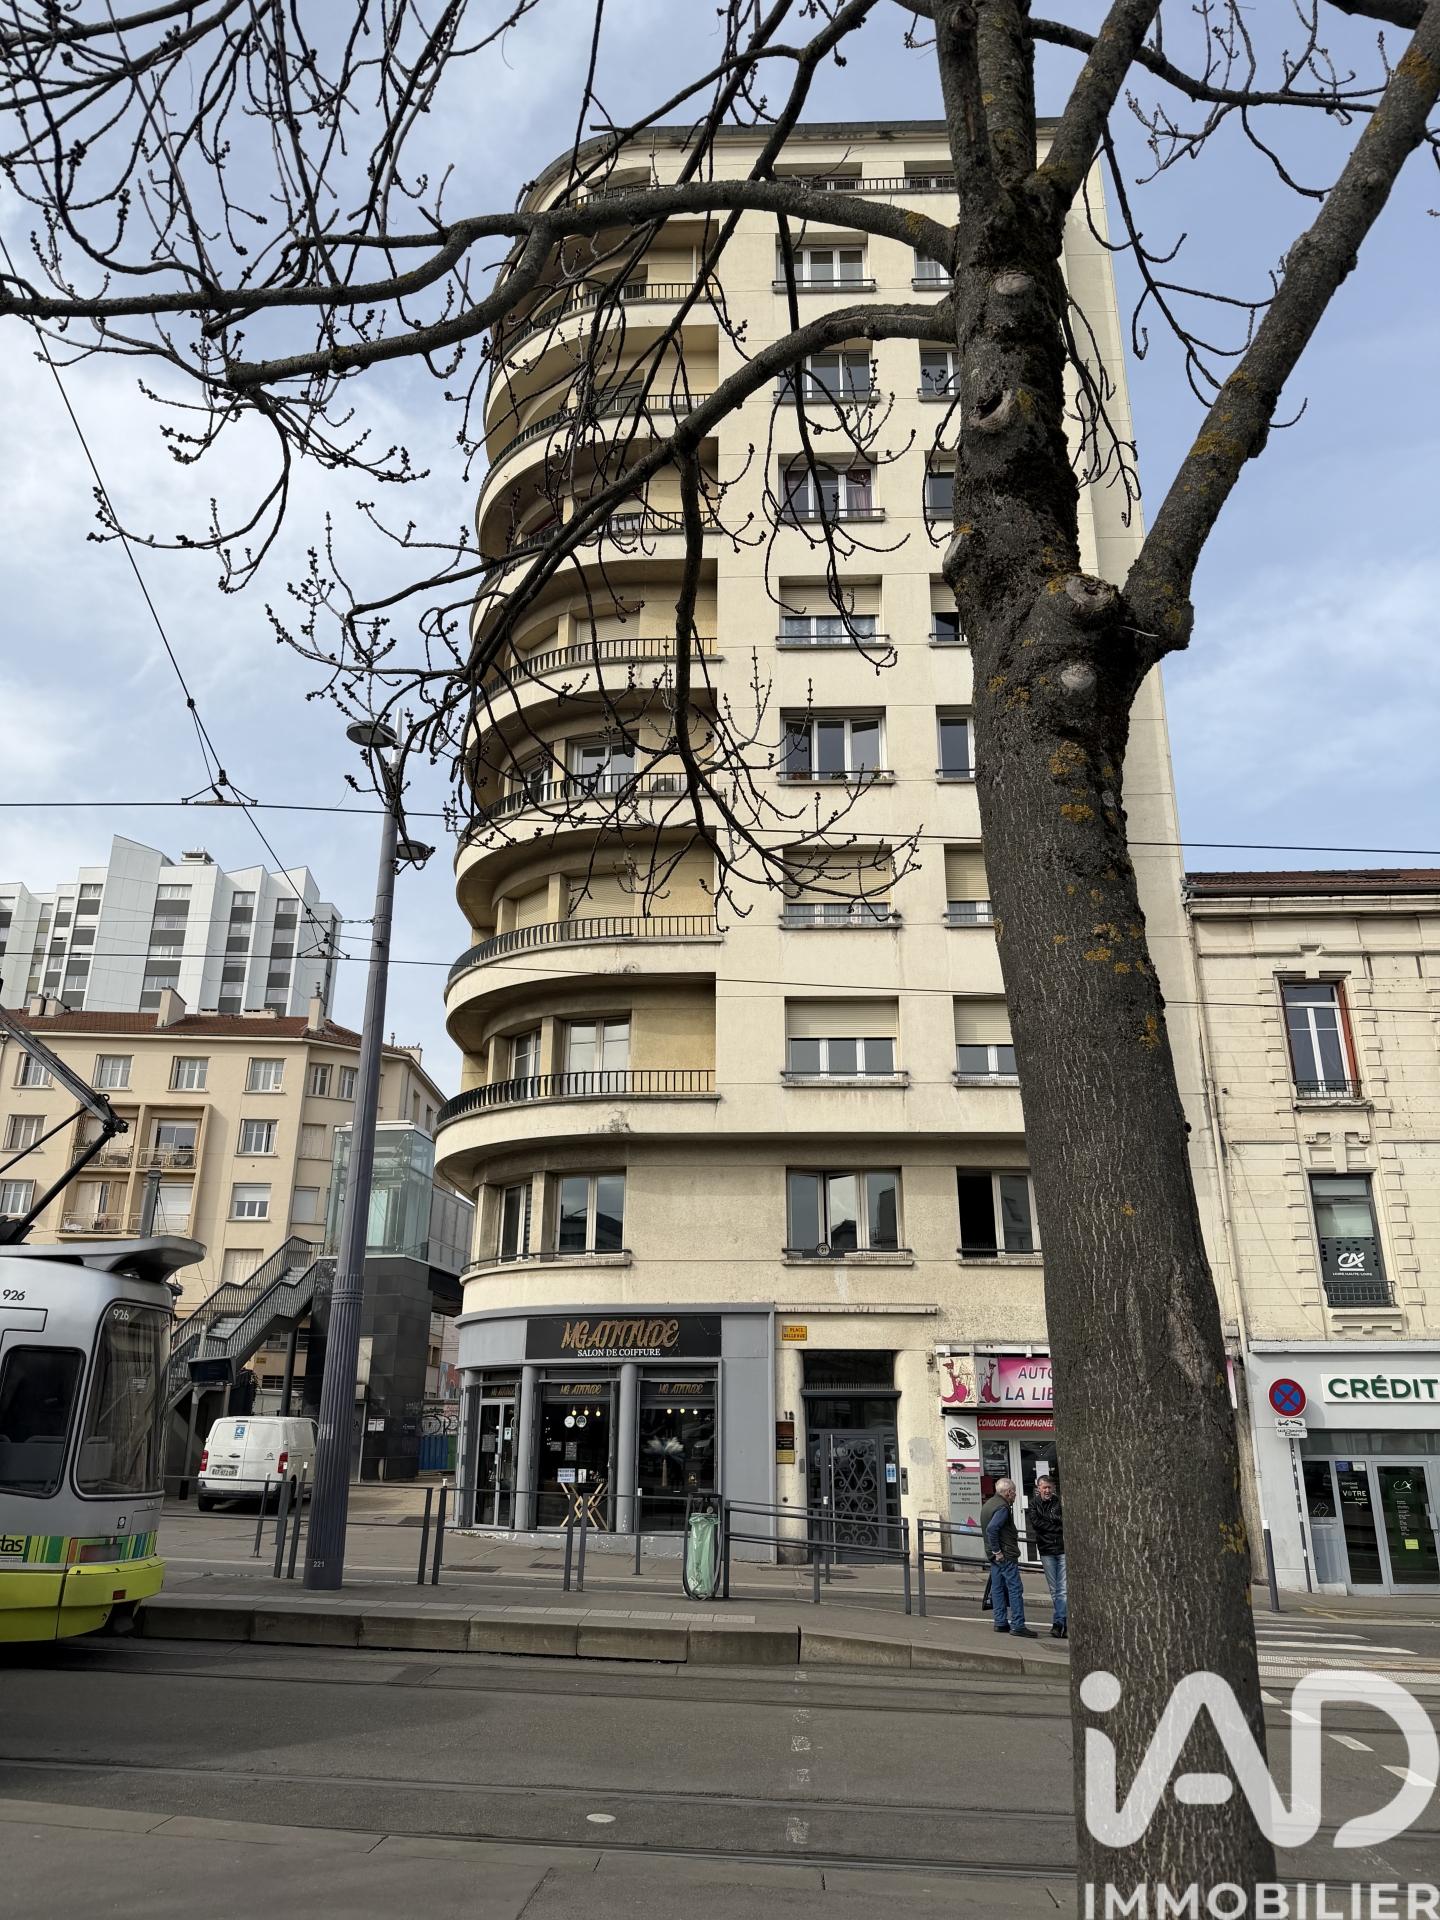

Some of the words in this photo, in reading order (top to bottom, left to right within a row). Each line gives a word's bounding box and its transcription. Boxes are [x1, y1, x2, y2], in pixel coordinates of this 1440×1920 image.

[3, 1289, 26, 1300] 926
[113, 1309, 129, 1320] 926
[577, 1349, 604, 1357] SALON
[618, 1348, 661, 1356] COIFFURE
[1328, 1375, 1439, 1399] CRÉDIT
[1005, 1386, 1024, 1401] LA
[783, 1411, 795, 1421] 12
[978, 1419, 1006, 1428] CONDUITE
[1009, 1418, 1054, 1427] ACCOMPAGNÉE
[312, 1560, 325, 1568] 221
